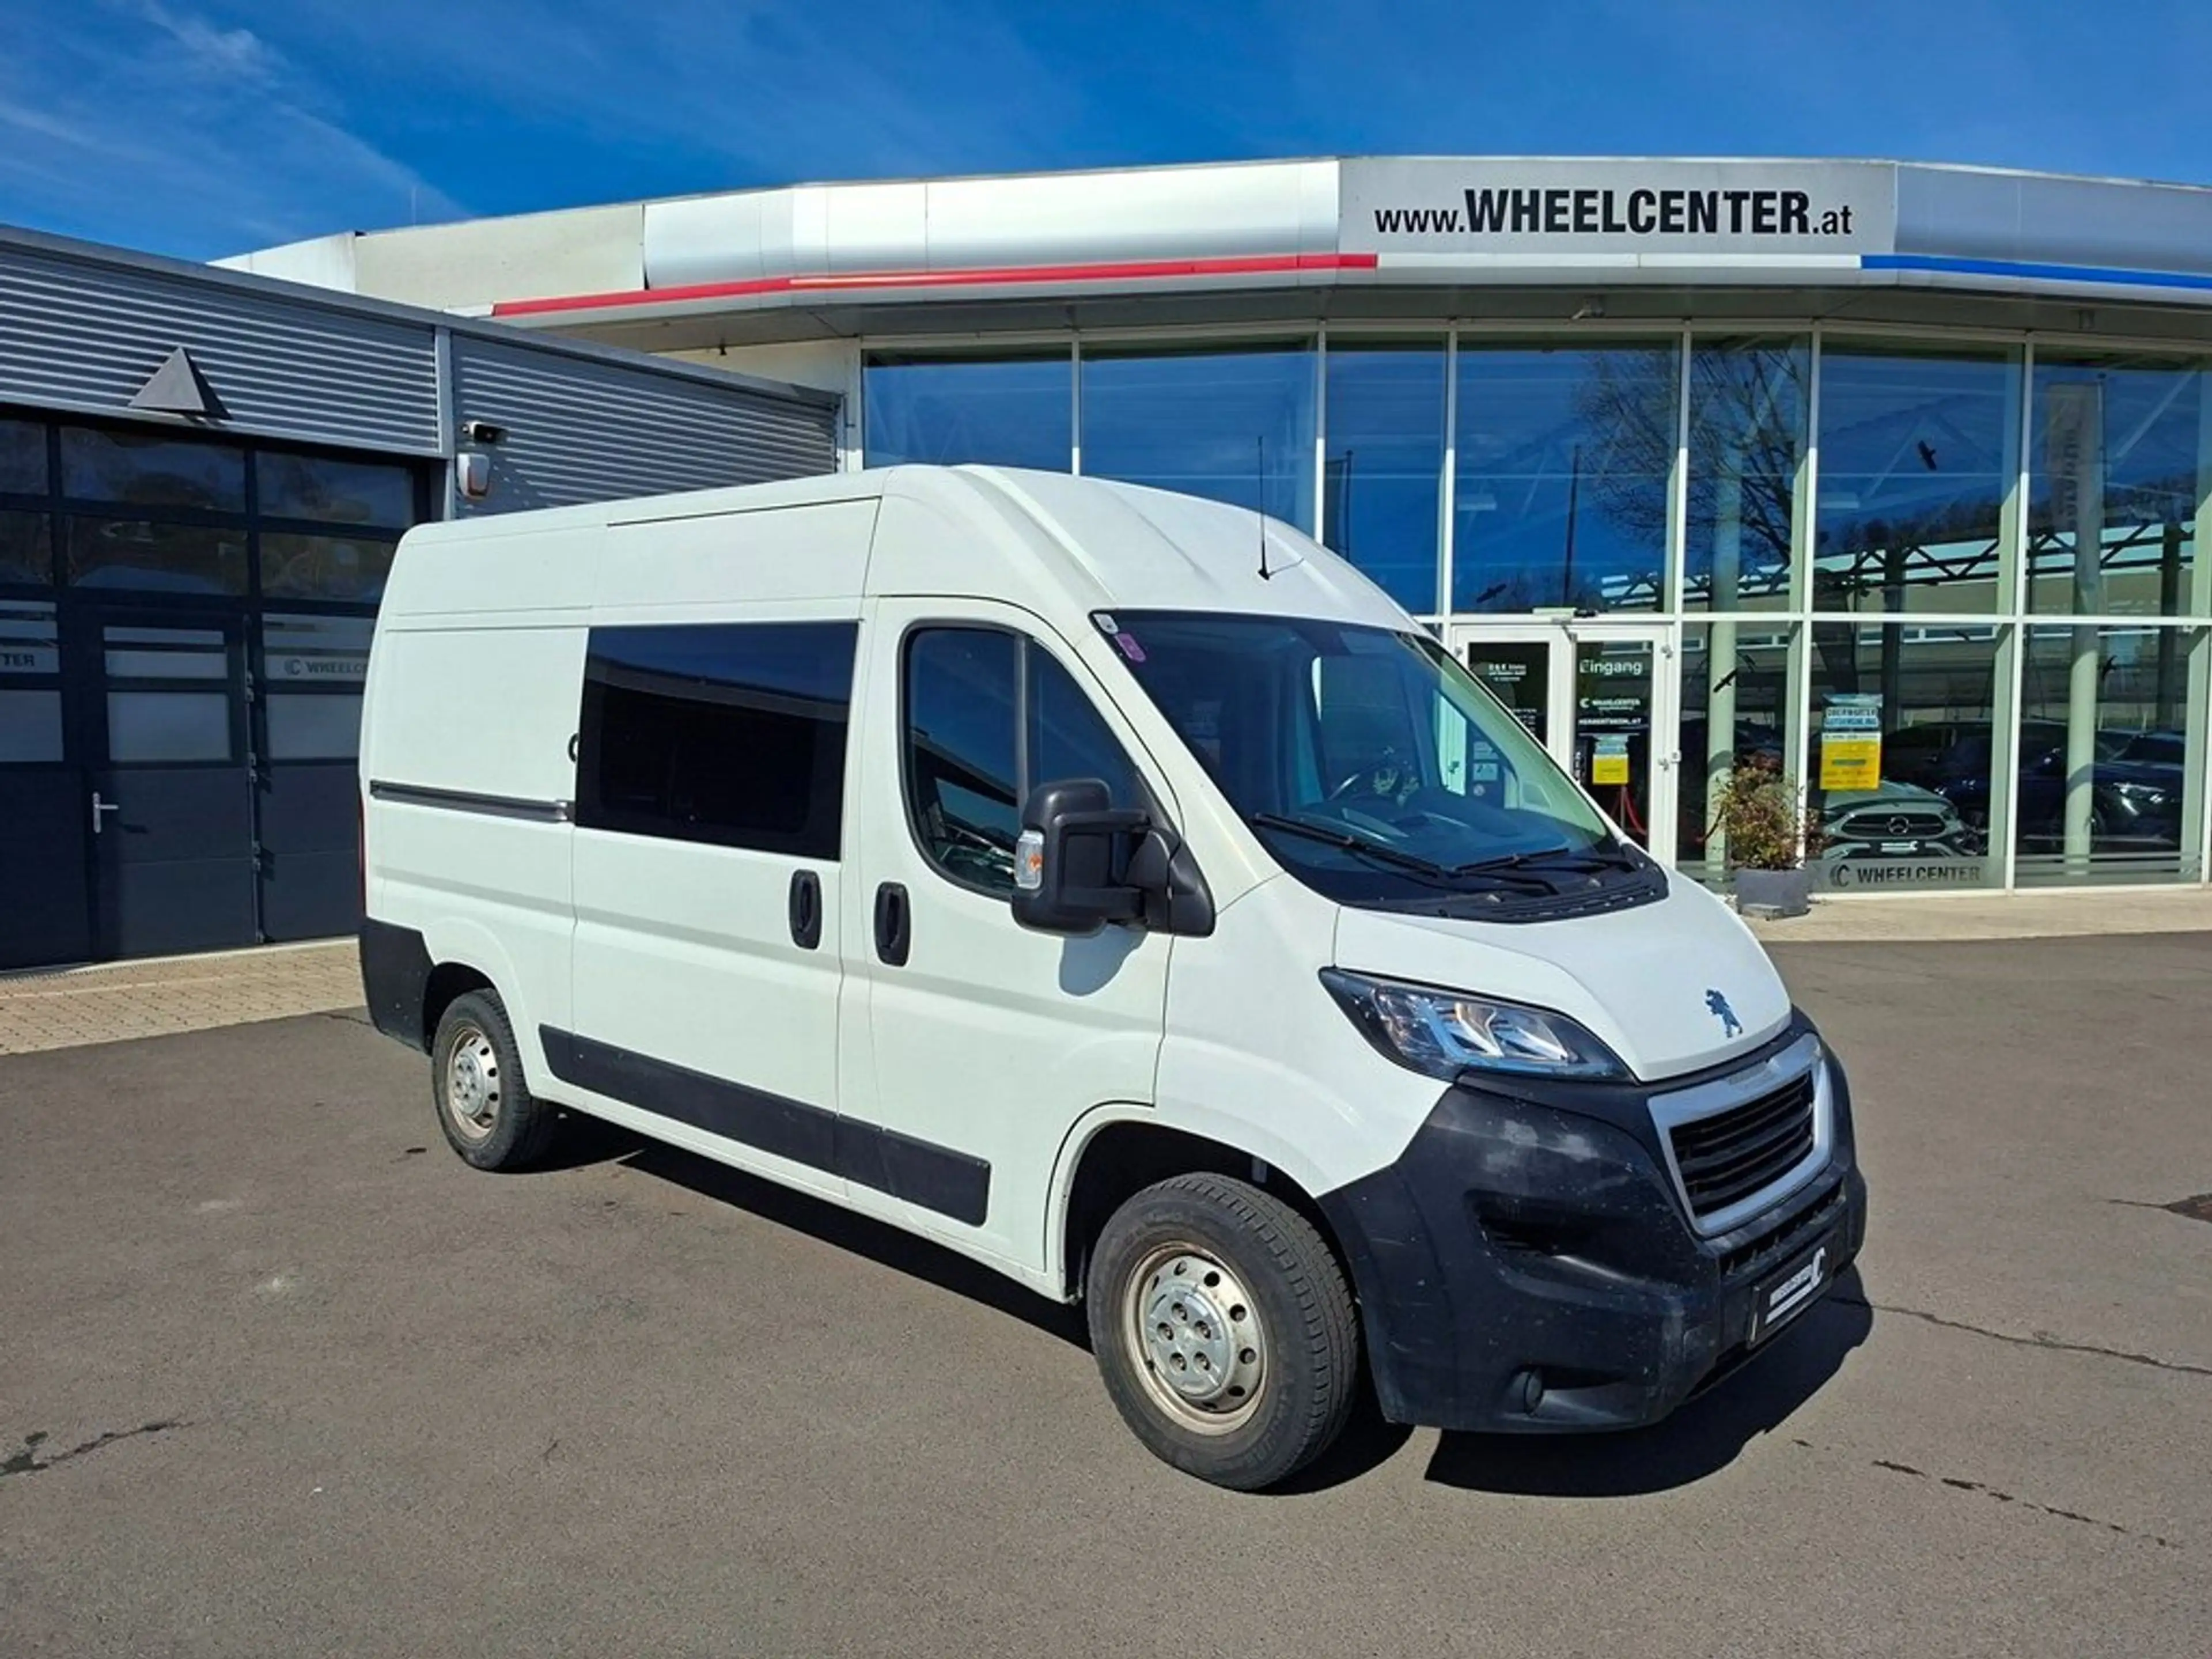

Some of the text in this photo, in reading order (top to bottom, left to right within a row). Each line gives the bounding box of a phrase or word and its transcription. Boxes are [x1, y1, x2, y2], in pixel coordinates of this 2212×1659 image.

[1375, 188, 1853, 234] www.WHEELCENTER.at
[1580, 659, 1643, 676] Eingang
[1857, 866, 1980, 883] WHEELCENTER
